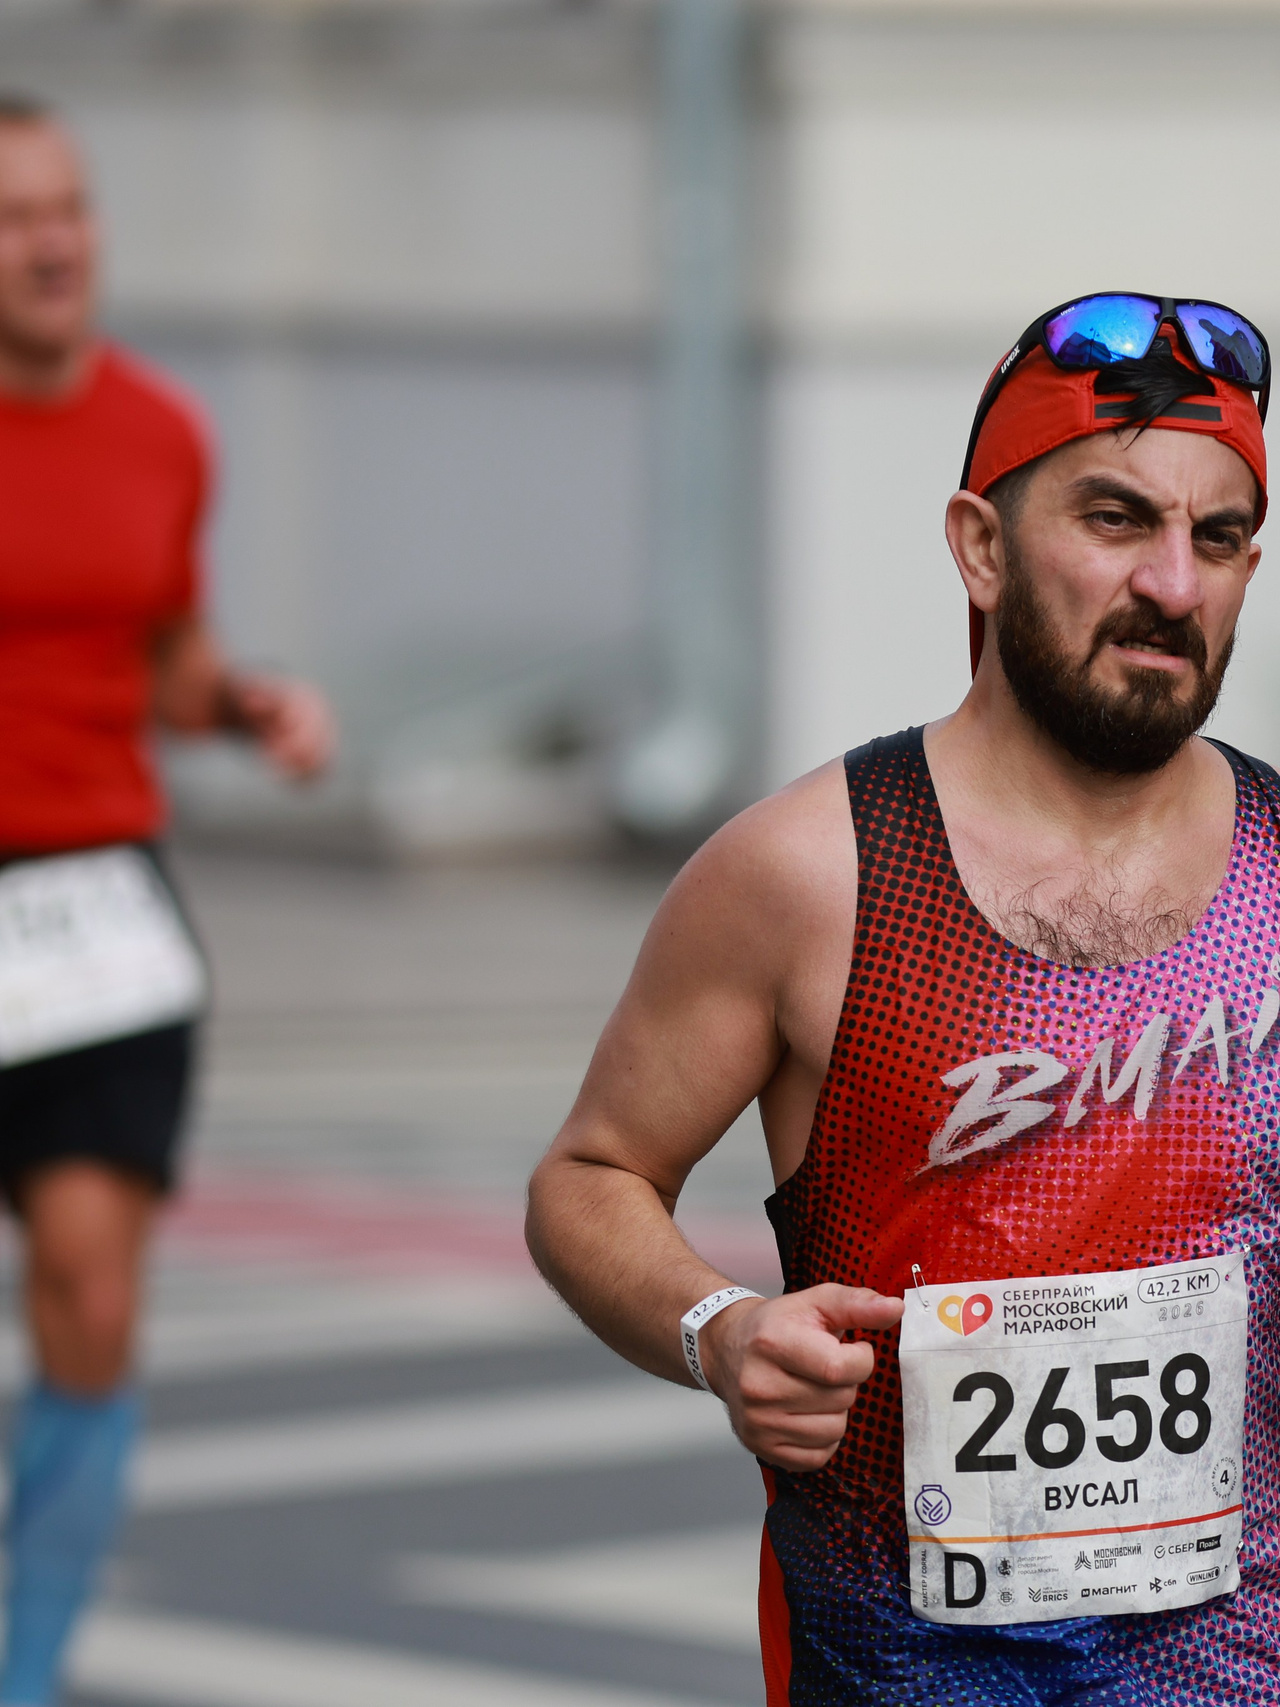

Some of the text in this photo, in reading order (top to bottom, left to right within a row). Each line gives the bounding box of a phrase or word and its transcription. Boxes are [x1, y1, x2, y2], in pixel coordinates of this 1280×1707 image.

[1001, 344, 1020, 373] uvex
[902, 988, 1280, 1182] BMAI
[1003, 1284, 1095, 1301] СБЕРПРАЙМ
[1147, 1279, 1180, 1297] 42,2
[1003, 1296, 1128, 1318] МОСКОВСКИЙ
[1004, 1316, 1096, 1335] МАРАФОН
[685, 1332, 704, 1382] 2658
[953, 1352, 1212, 1473] 2658
[1220, 1470, 1229, 1485] 4
[1044, 1479, 1139, 1511] ВУСАЛ
[1094, 1543, 1142, 1559] МОСКОВСКИЙ
[1168, 1543, 1195, 1555] СБЕР
[1094, 1558, 1117, 1570] СПОРТ
[944, 1552, 987, 1608] D
[1189, 1571, 1215, 1583] WINLINE
[1043, 1593, 1068, 1602] BRICS
